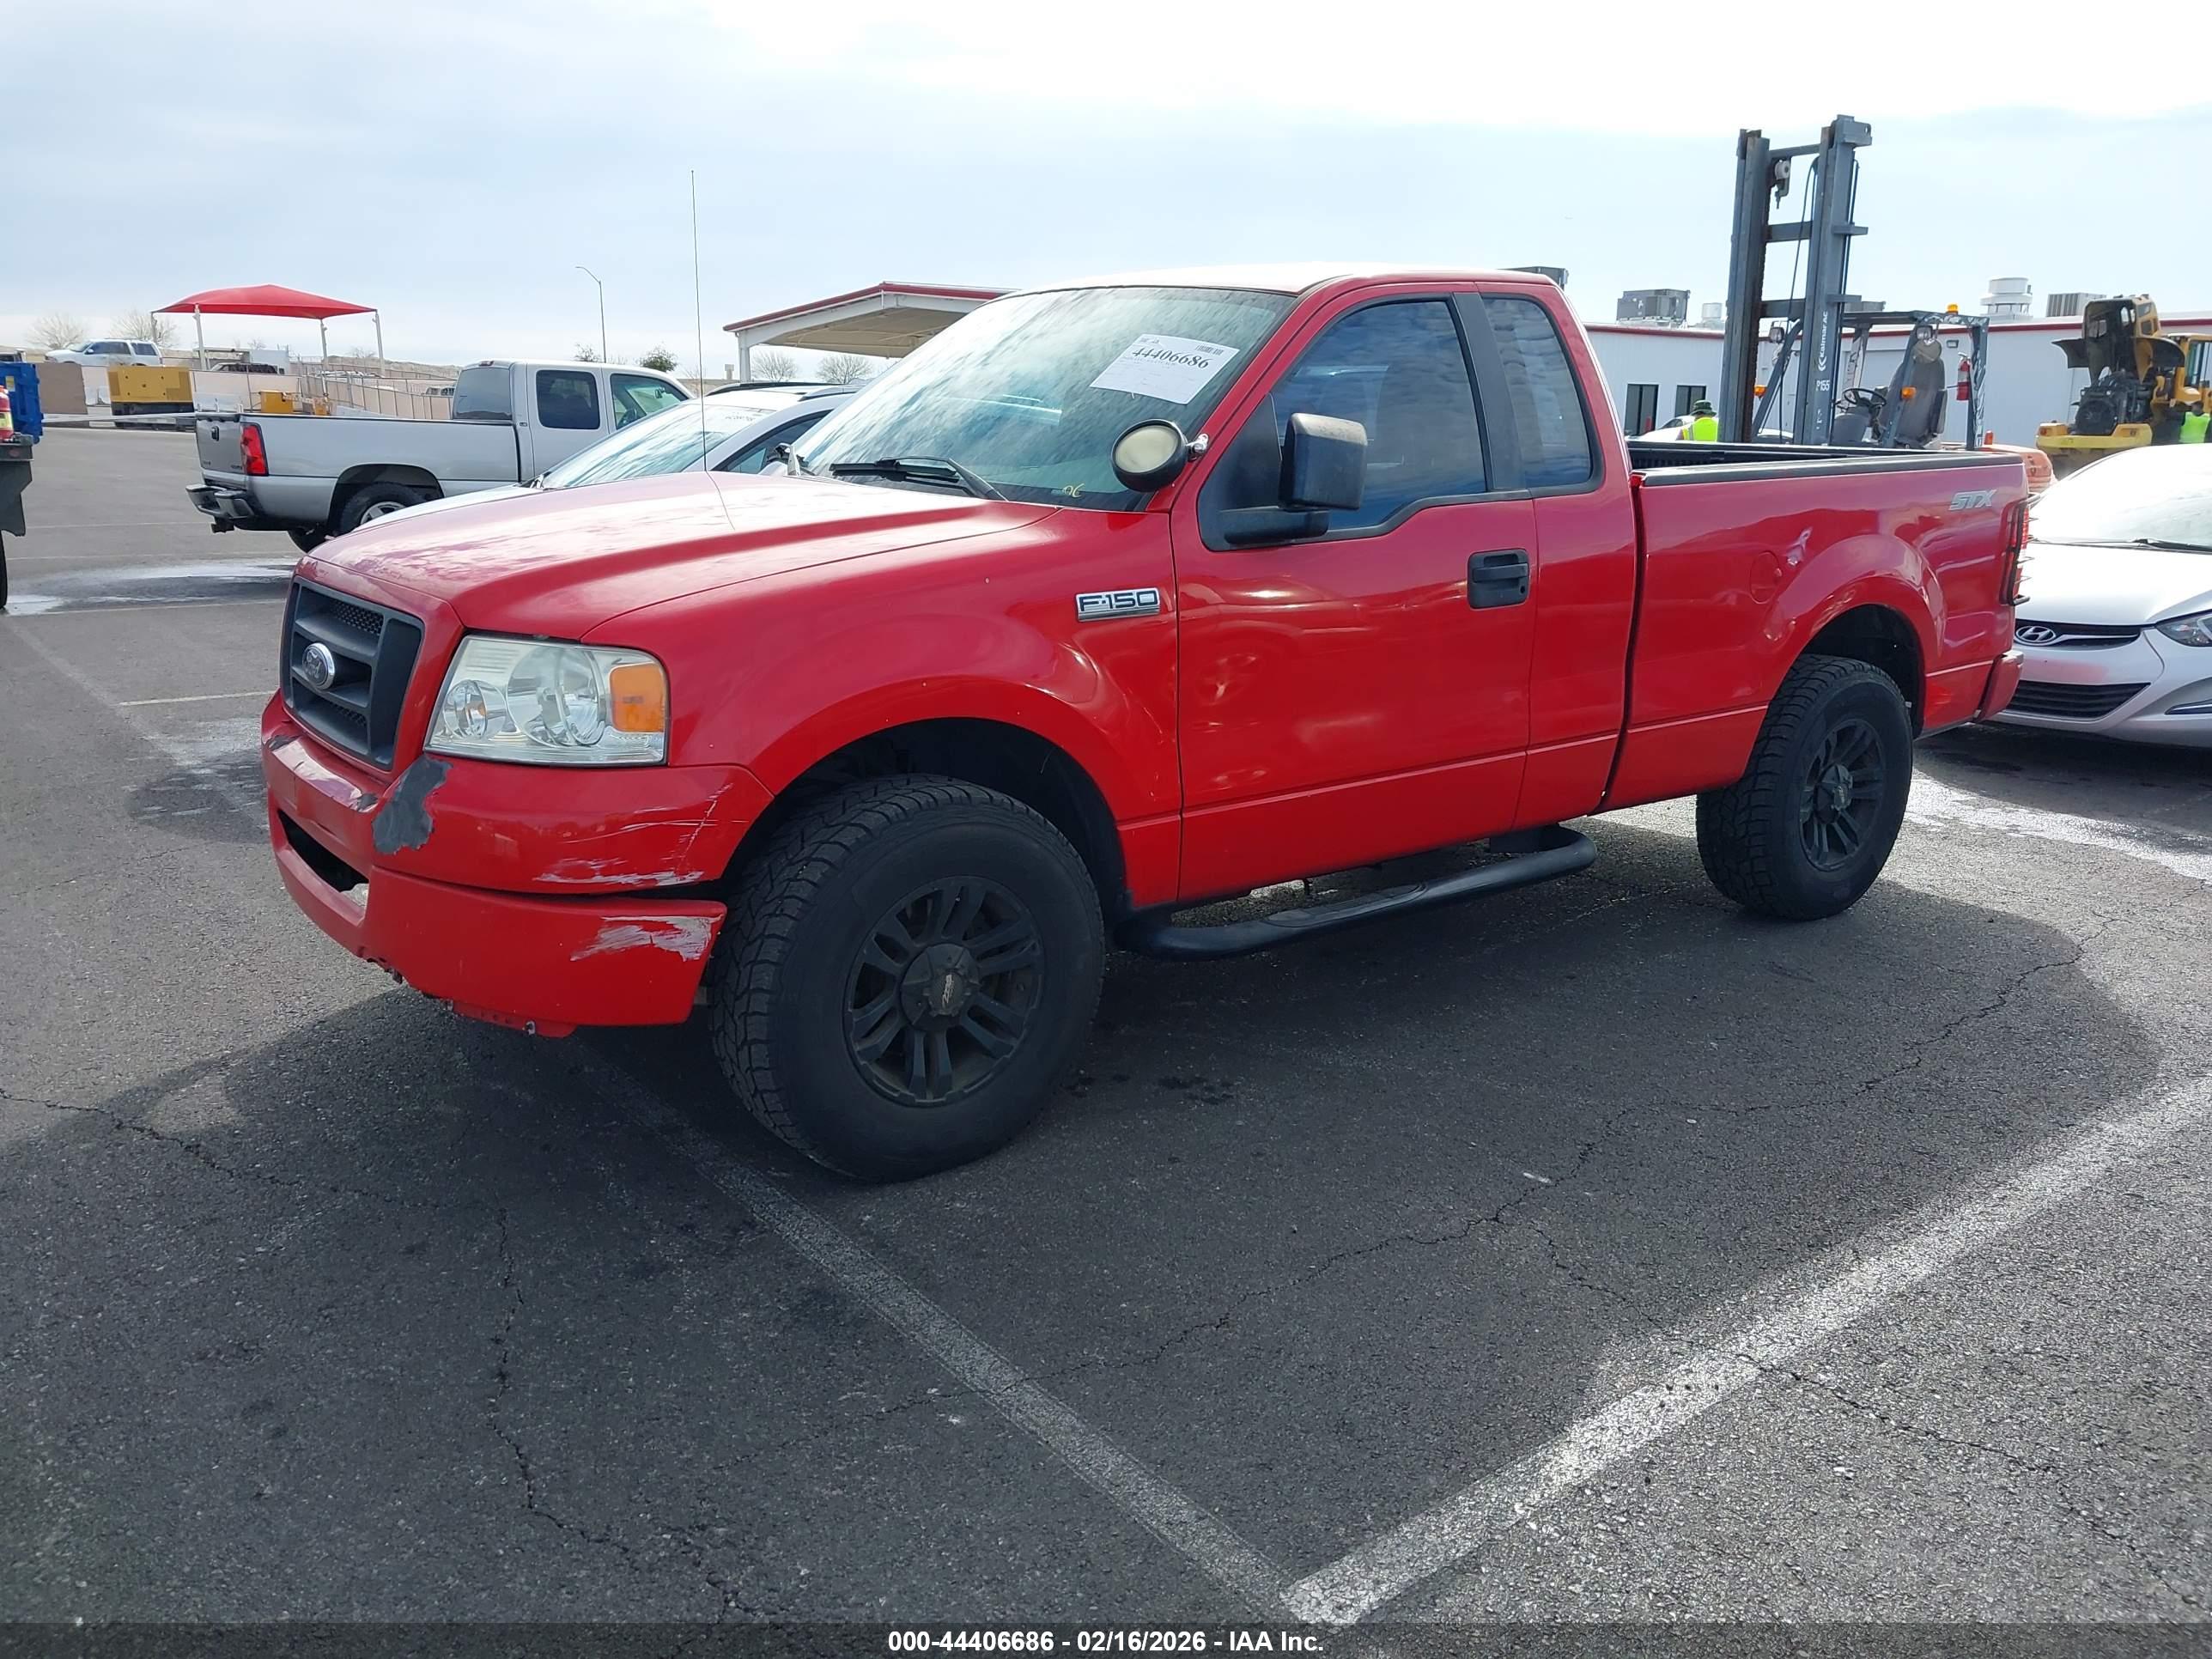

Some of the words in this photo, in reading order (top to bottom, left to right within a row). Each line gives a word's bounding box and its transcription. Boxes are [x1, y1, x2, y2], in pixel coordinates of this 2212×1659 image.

[1132, 347, 1213, 368] 44406686
[1948, 489, 1997, 511] STX
[1079, 589, 1158, 612] F-150
